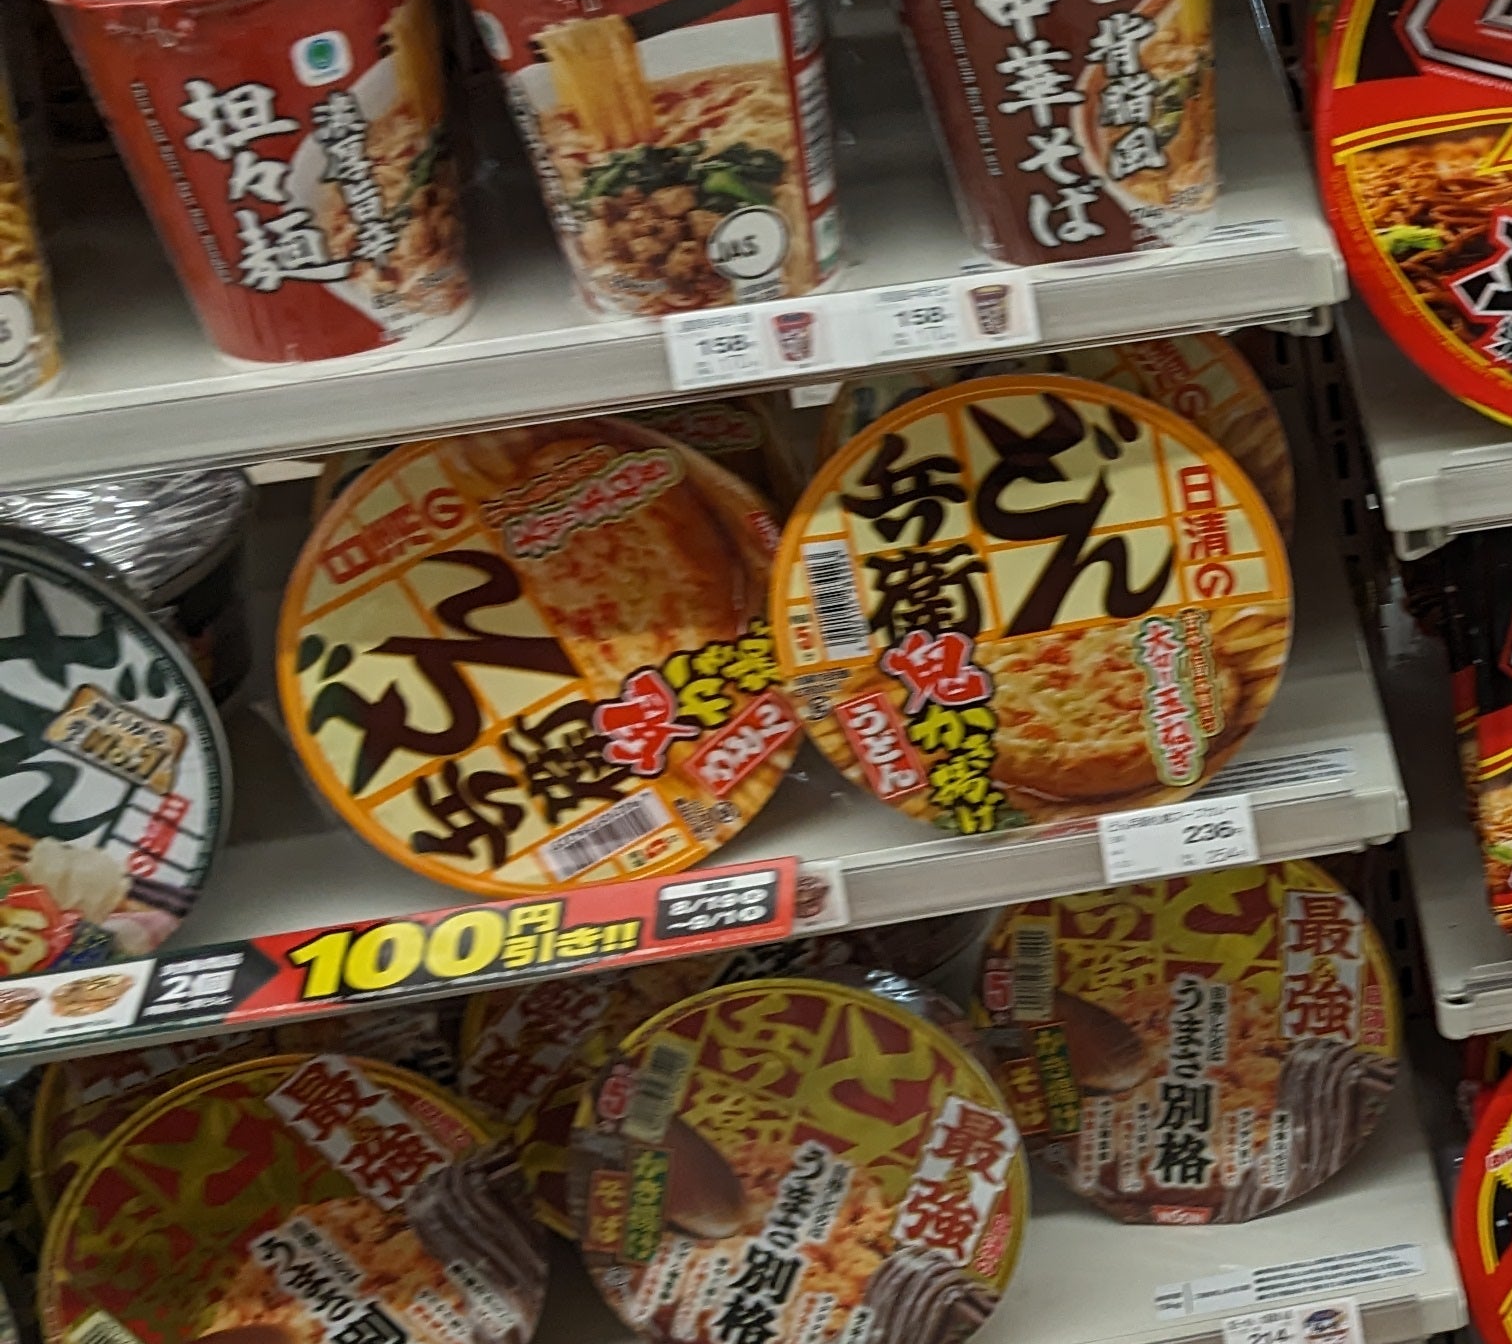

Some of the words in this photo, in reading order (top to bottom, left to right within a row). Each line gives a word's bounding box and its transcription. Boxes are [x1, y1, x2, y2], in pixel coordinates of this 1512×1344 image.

[1086, 12, 1170, 180] 背脂風
[179, 79, 351, 292] 担々麺
[312, 91, 404, 262] 濃厚旨辛
[320, 486, 467, 587] 日清の
[840, 432, 989, 644] 兵衛
[966, 391, 1178, 636] どん
[1180, 462, 1236, 597] 日清の
[296, 549, 581, 797] どん
[881, 629, 993, 714] 鬼
[411, 701, 640, 870] 兵衛
[848, 700, 920, 795] うどん
[910, 706, 1008, 834] かき揚げ
[1181, 820, 1235, 846] 236
[162, 965, 237, 1003] 2個
[1289, 898, 1361, 1042] 最強
[1009, 1064, 1048, 1132] そば
[1036, 1027, 1082, 1135] かき揚げ
[1156, 978, 1212, 1185] うまさ別格
[903, 1104, 1004, 1266] 最強
